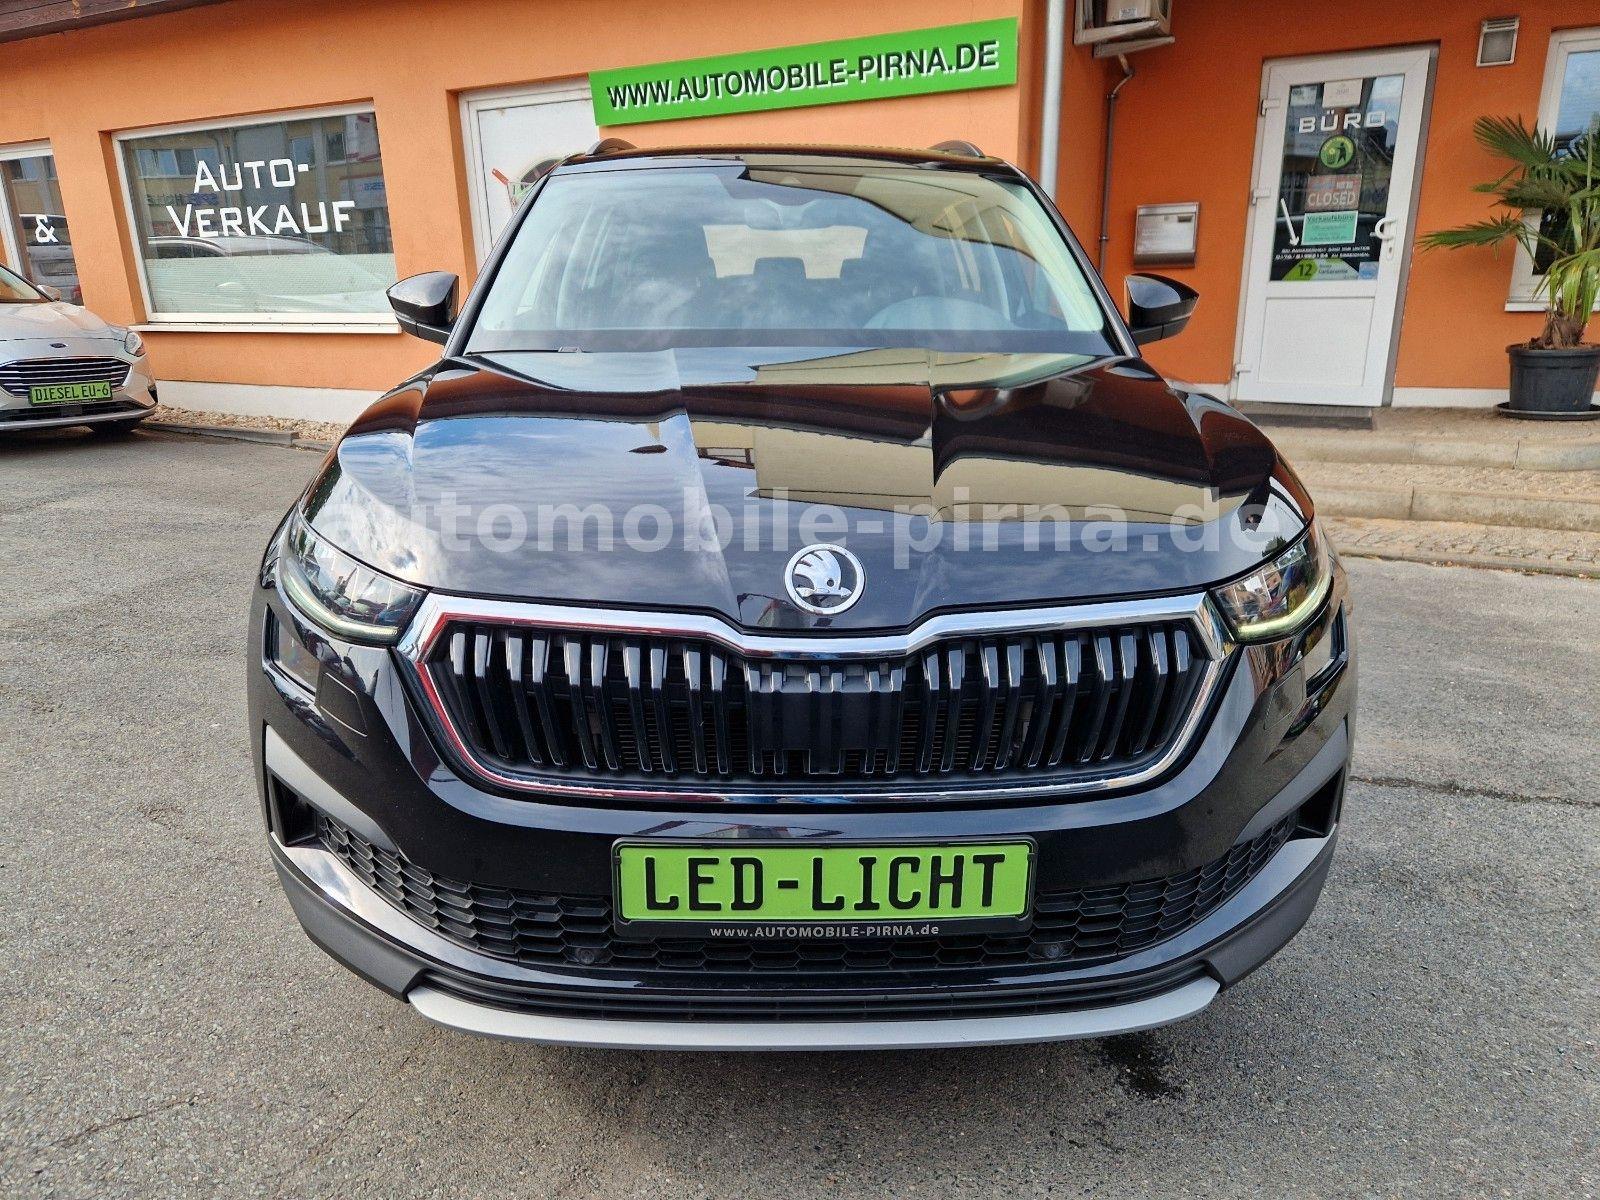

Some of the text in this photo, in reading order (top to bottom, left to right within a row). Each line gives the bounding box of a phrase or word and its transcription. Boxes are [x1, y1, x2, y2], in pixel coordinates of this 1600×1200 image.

[606, 39, 1000, 111] WWW.AUTOMOBILE-PIRNA.DE
[1298, 109, 1387, 134] BÜRO
[193, 158, 310, 194] AUTO-
[1307, 191, 1356, 206] CLOSED
[34, 215, 60, 243] &
[166, 200, 356, 238] VERKAUF
[1299, 264, 1313, 277] 12
[34, 384, 109, 401] DIESEL EU-6
[643, 854, 1006, 911] LED-LICHT
[710, 923, 940, 938] www.AUTOMOBILE-PIRNA.de
